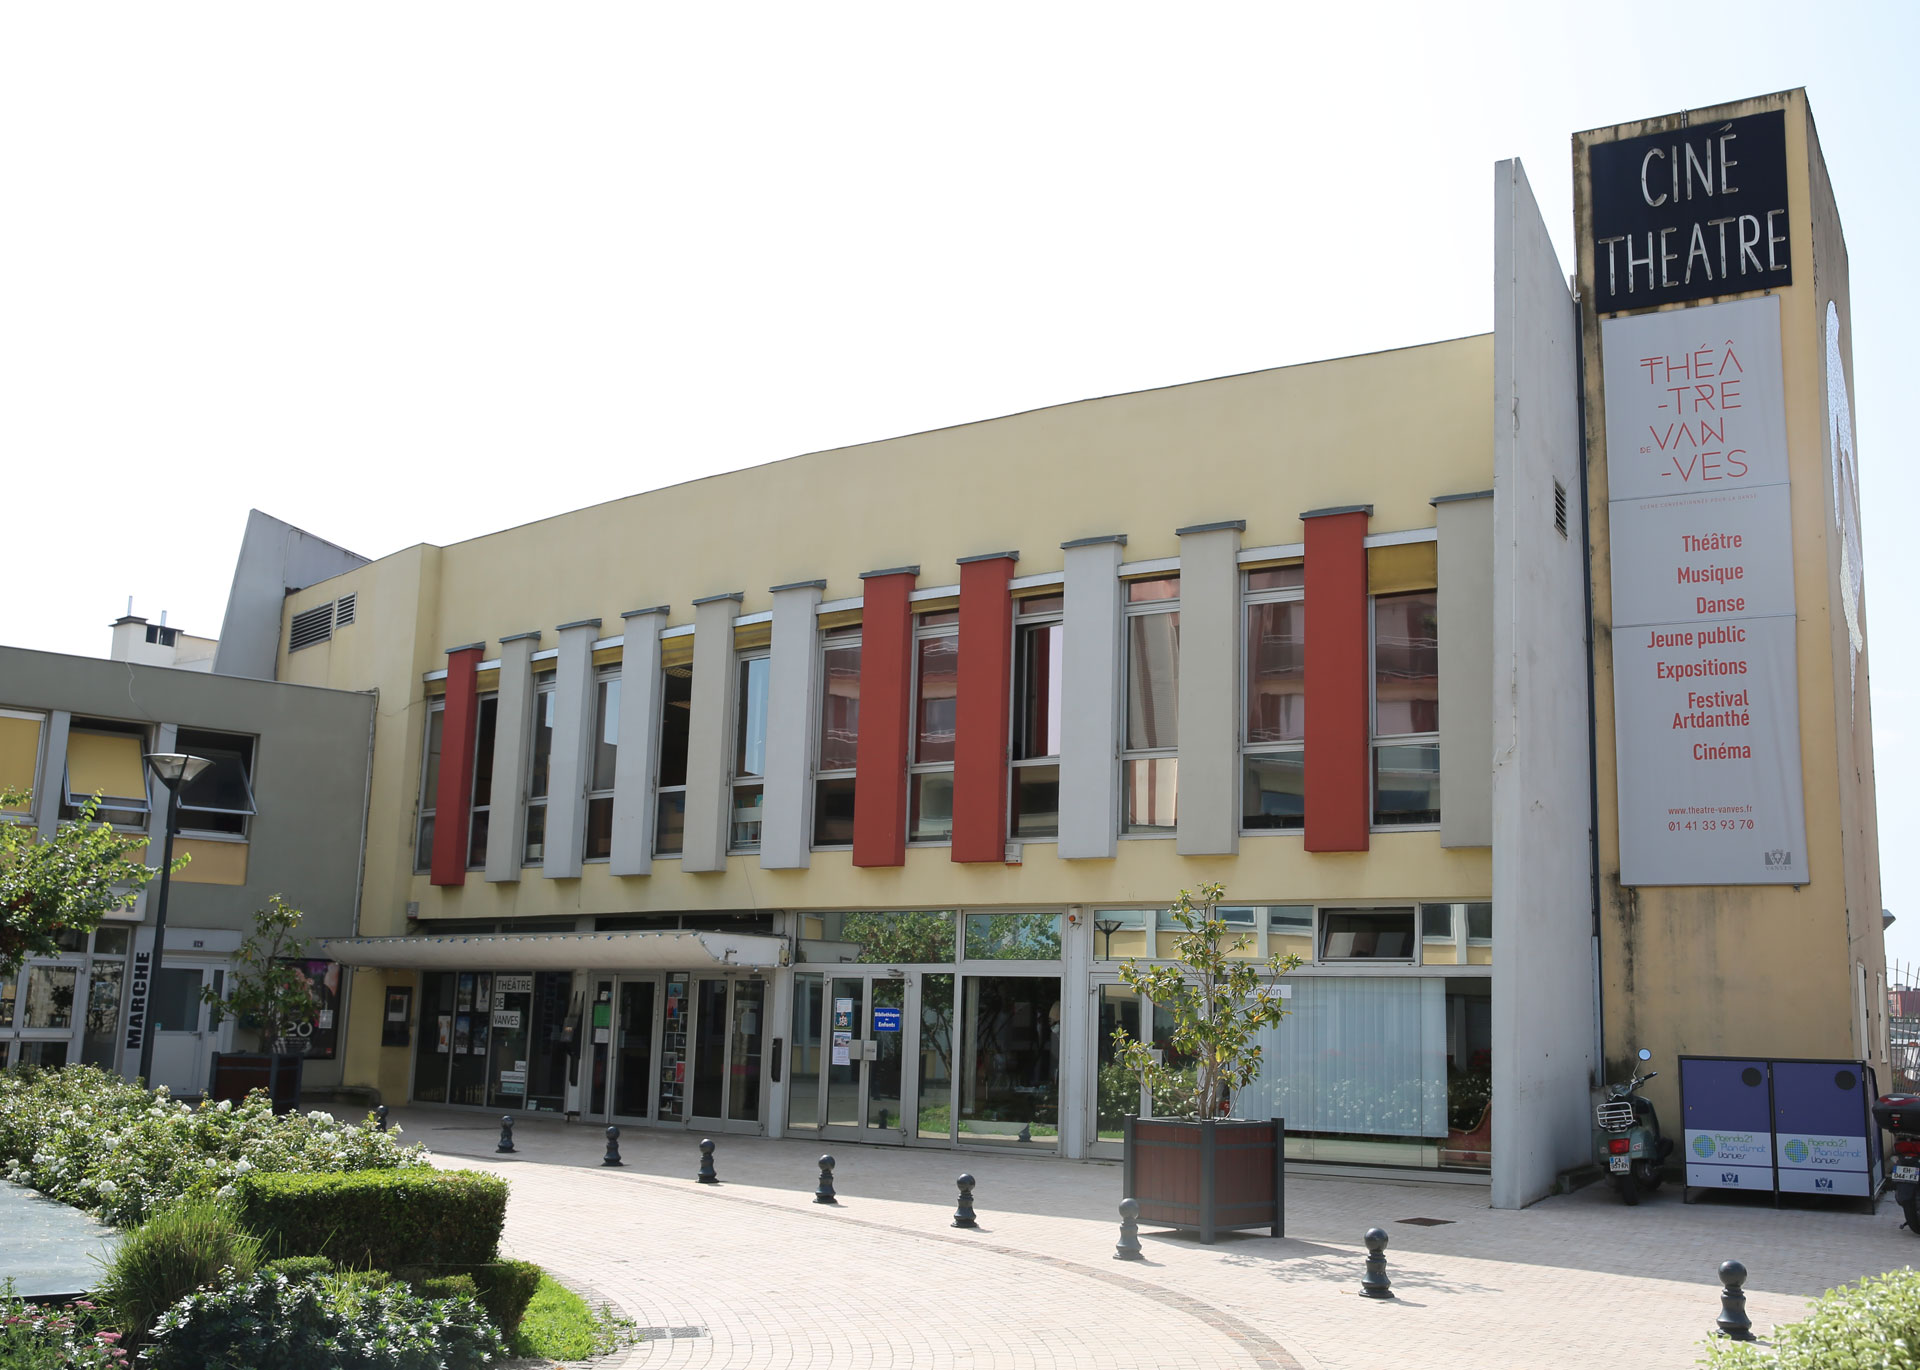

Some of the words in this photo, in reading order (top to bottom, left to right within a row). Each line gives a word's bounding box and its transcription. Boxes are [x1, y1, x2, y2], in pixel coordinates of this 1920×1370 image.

[1641, 122, 1739, 207] CINÉ
[1598, 208, 1788, 296] THEATRE
[1649, 417, 1724, 450] VAN
[1682, 532, 1743, 552] Théâtre
[1677, 564, 1744, 584] Musique
[1696, 596, 1745, 614] Danse
[1647, 631, 1693, 649] Jeune
[1698, 625, 1746, 649] public
[1656, 658, 1748, 682] Expositions
[1688, 689, 1749, 709] Festival
[1672, 709, 1750, 729] Artdanthé
[1693, 742, 1751, 760] Cinéma
[1668, 804, 1753, 815] www.theatre-vanves.fr
[1668, 821, 1681, 831] 01
[1684, 821, 1698, 831] 41
[1702, 820, 1716, 831] 33
[1720, 820, 1735, 830] 93
[1739, 819, 1754, 830] 70
[126, 951, 150, 1049] MARCHE
[494, 1015, 519, 1026] VANVES
